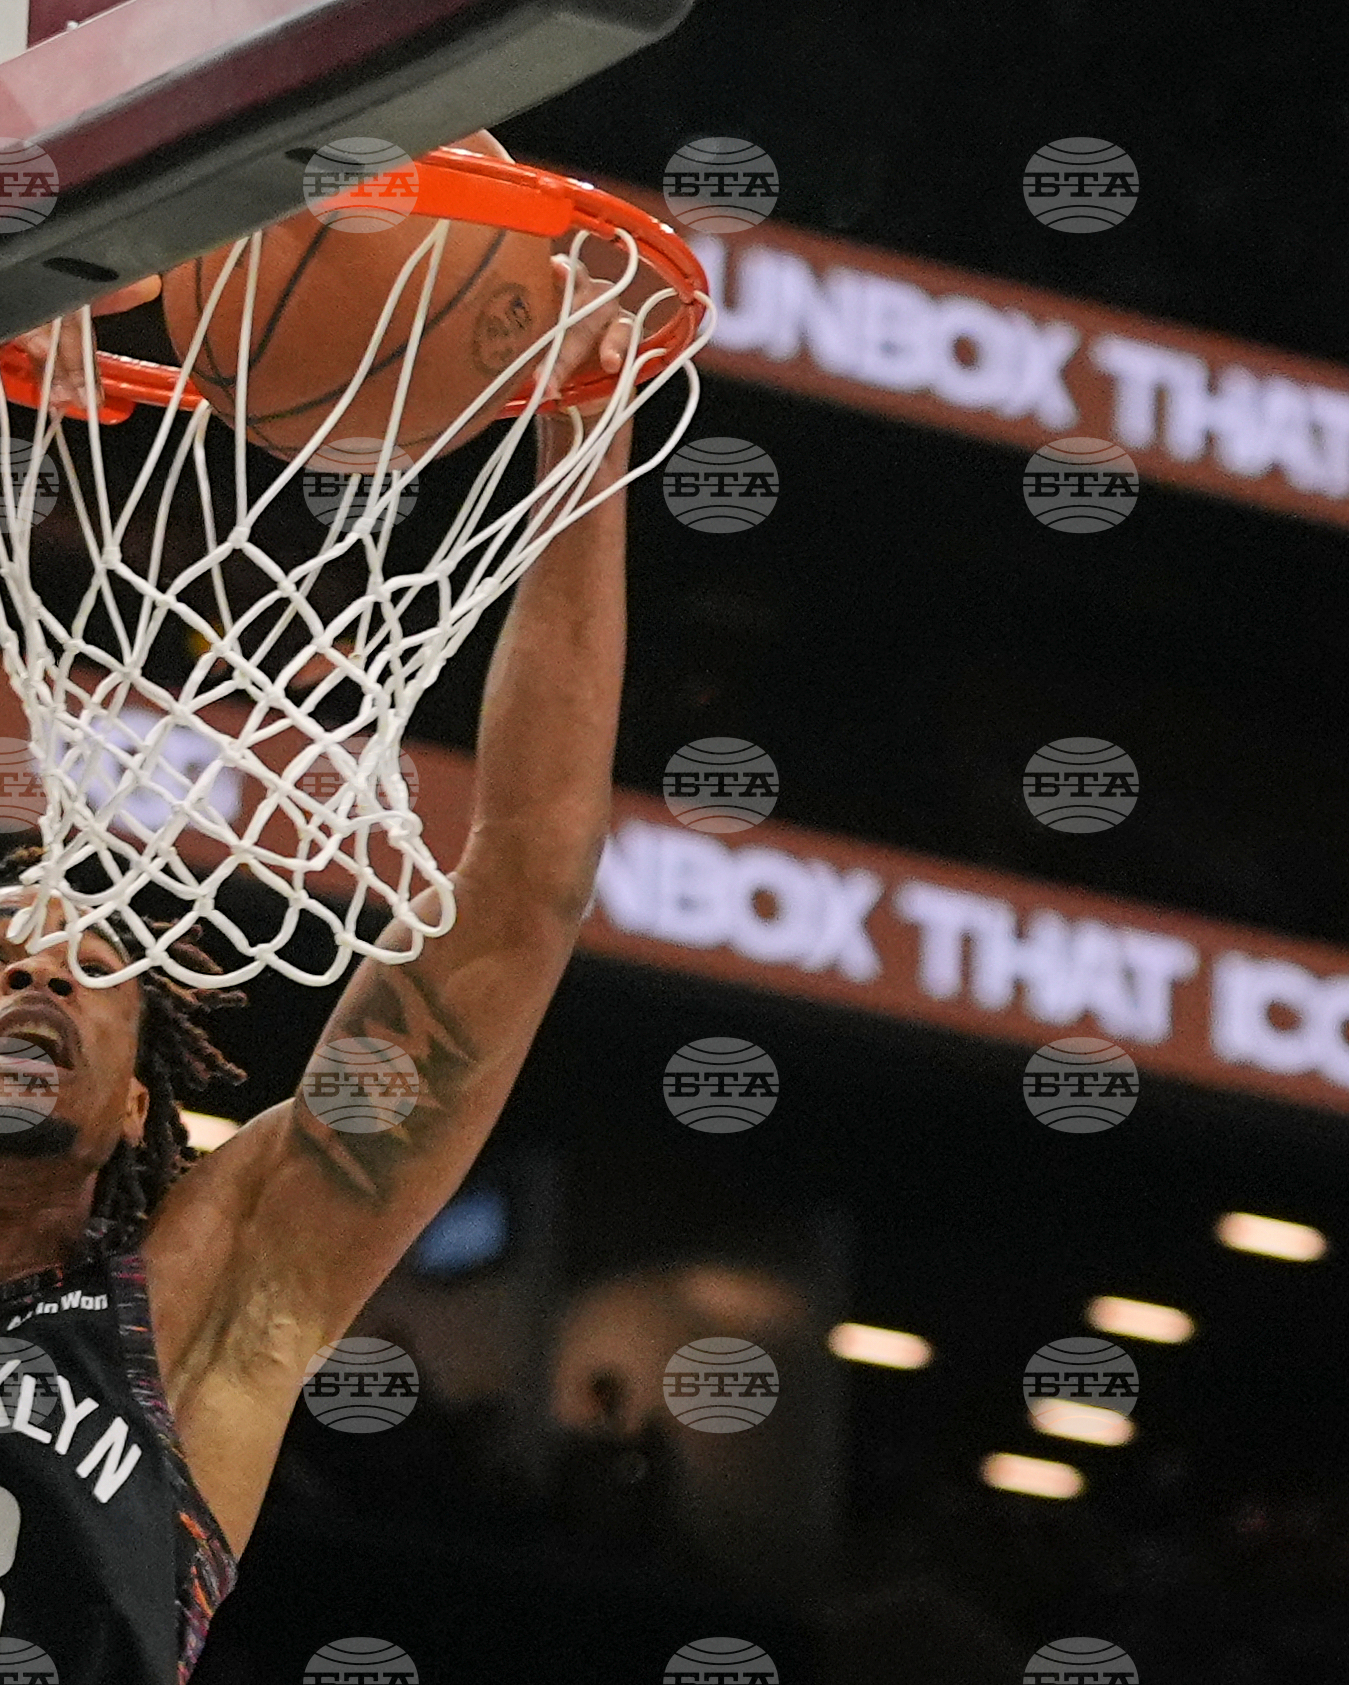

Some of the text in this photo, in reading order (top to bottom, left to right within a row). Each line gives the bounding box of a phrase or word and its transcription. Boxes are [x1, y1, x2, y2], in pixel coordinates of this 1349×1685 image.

[595, 818, 884, 984] NBOX
[892, 876, 1201, 1046] THAT
[61, 1290, 108, 1311] Won
